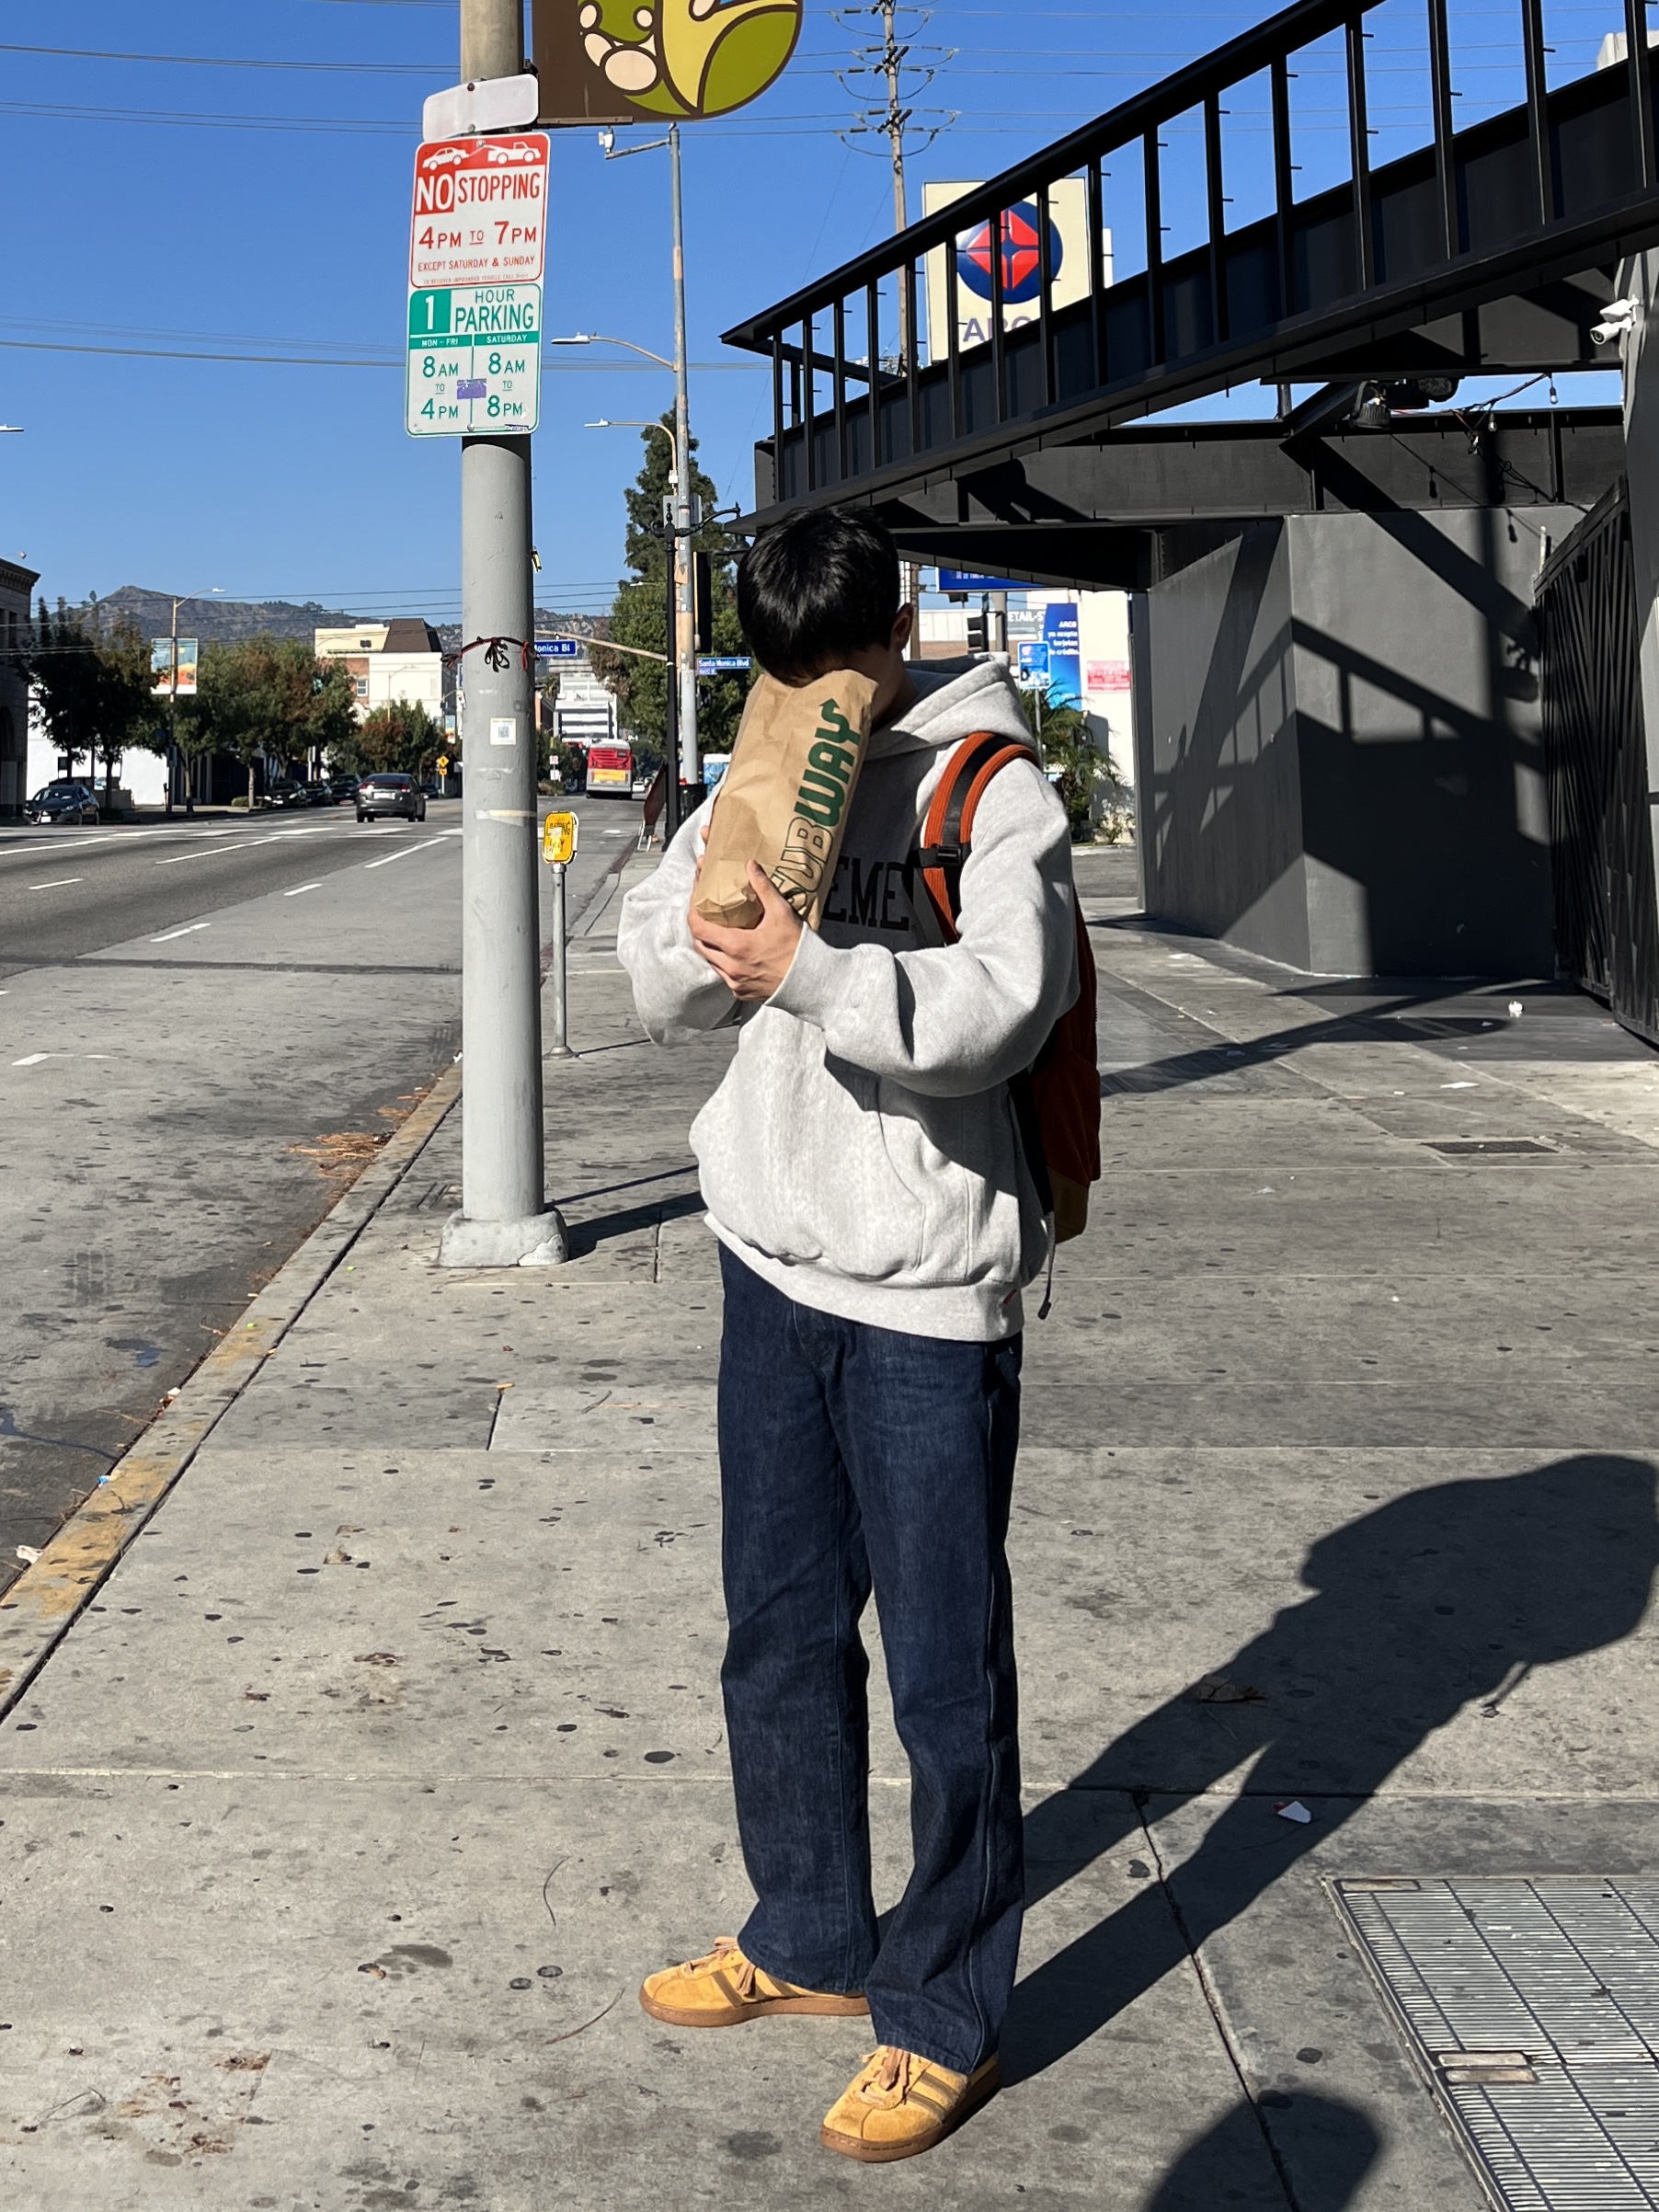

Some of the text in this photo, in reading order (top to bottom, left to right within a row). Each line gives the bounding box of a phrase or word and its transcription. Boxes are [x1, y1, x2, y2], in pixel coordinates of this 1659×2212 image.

[416, 172, 540, 212] NO STOPPING
[469, 230, 484, 242] TO
[418, 255, 535, 271] EXCEPT SATURDAY & SUNDAY
[475, 289, 515, 304] HOUR
[425, 294, 434, 330] 1
[455, 303, 533, 333] PARKING
[486, 334, 527, 344] SATURDAY
[435, 384, 445, 392] TO
[502, 380, 512, 389] TO
[737, 659, 749, 667] Blvd
